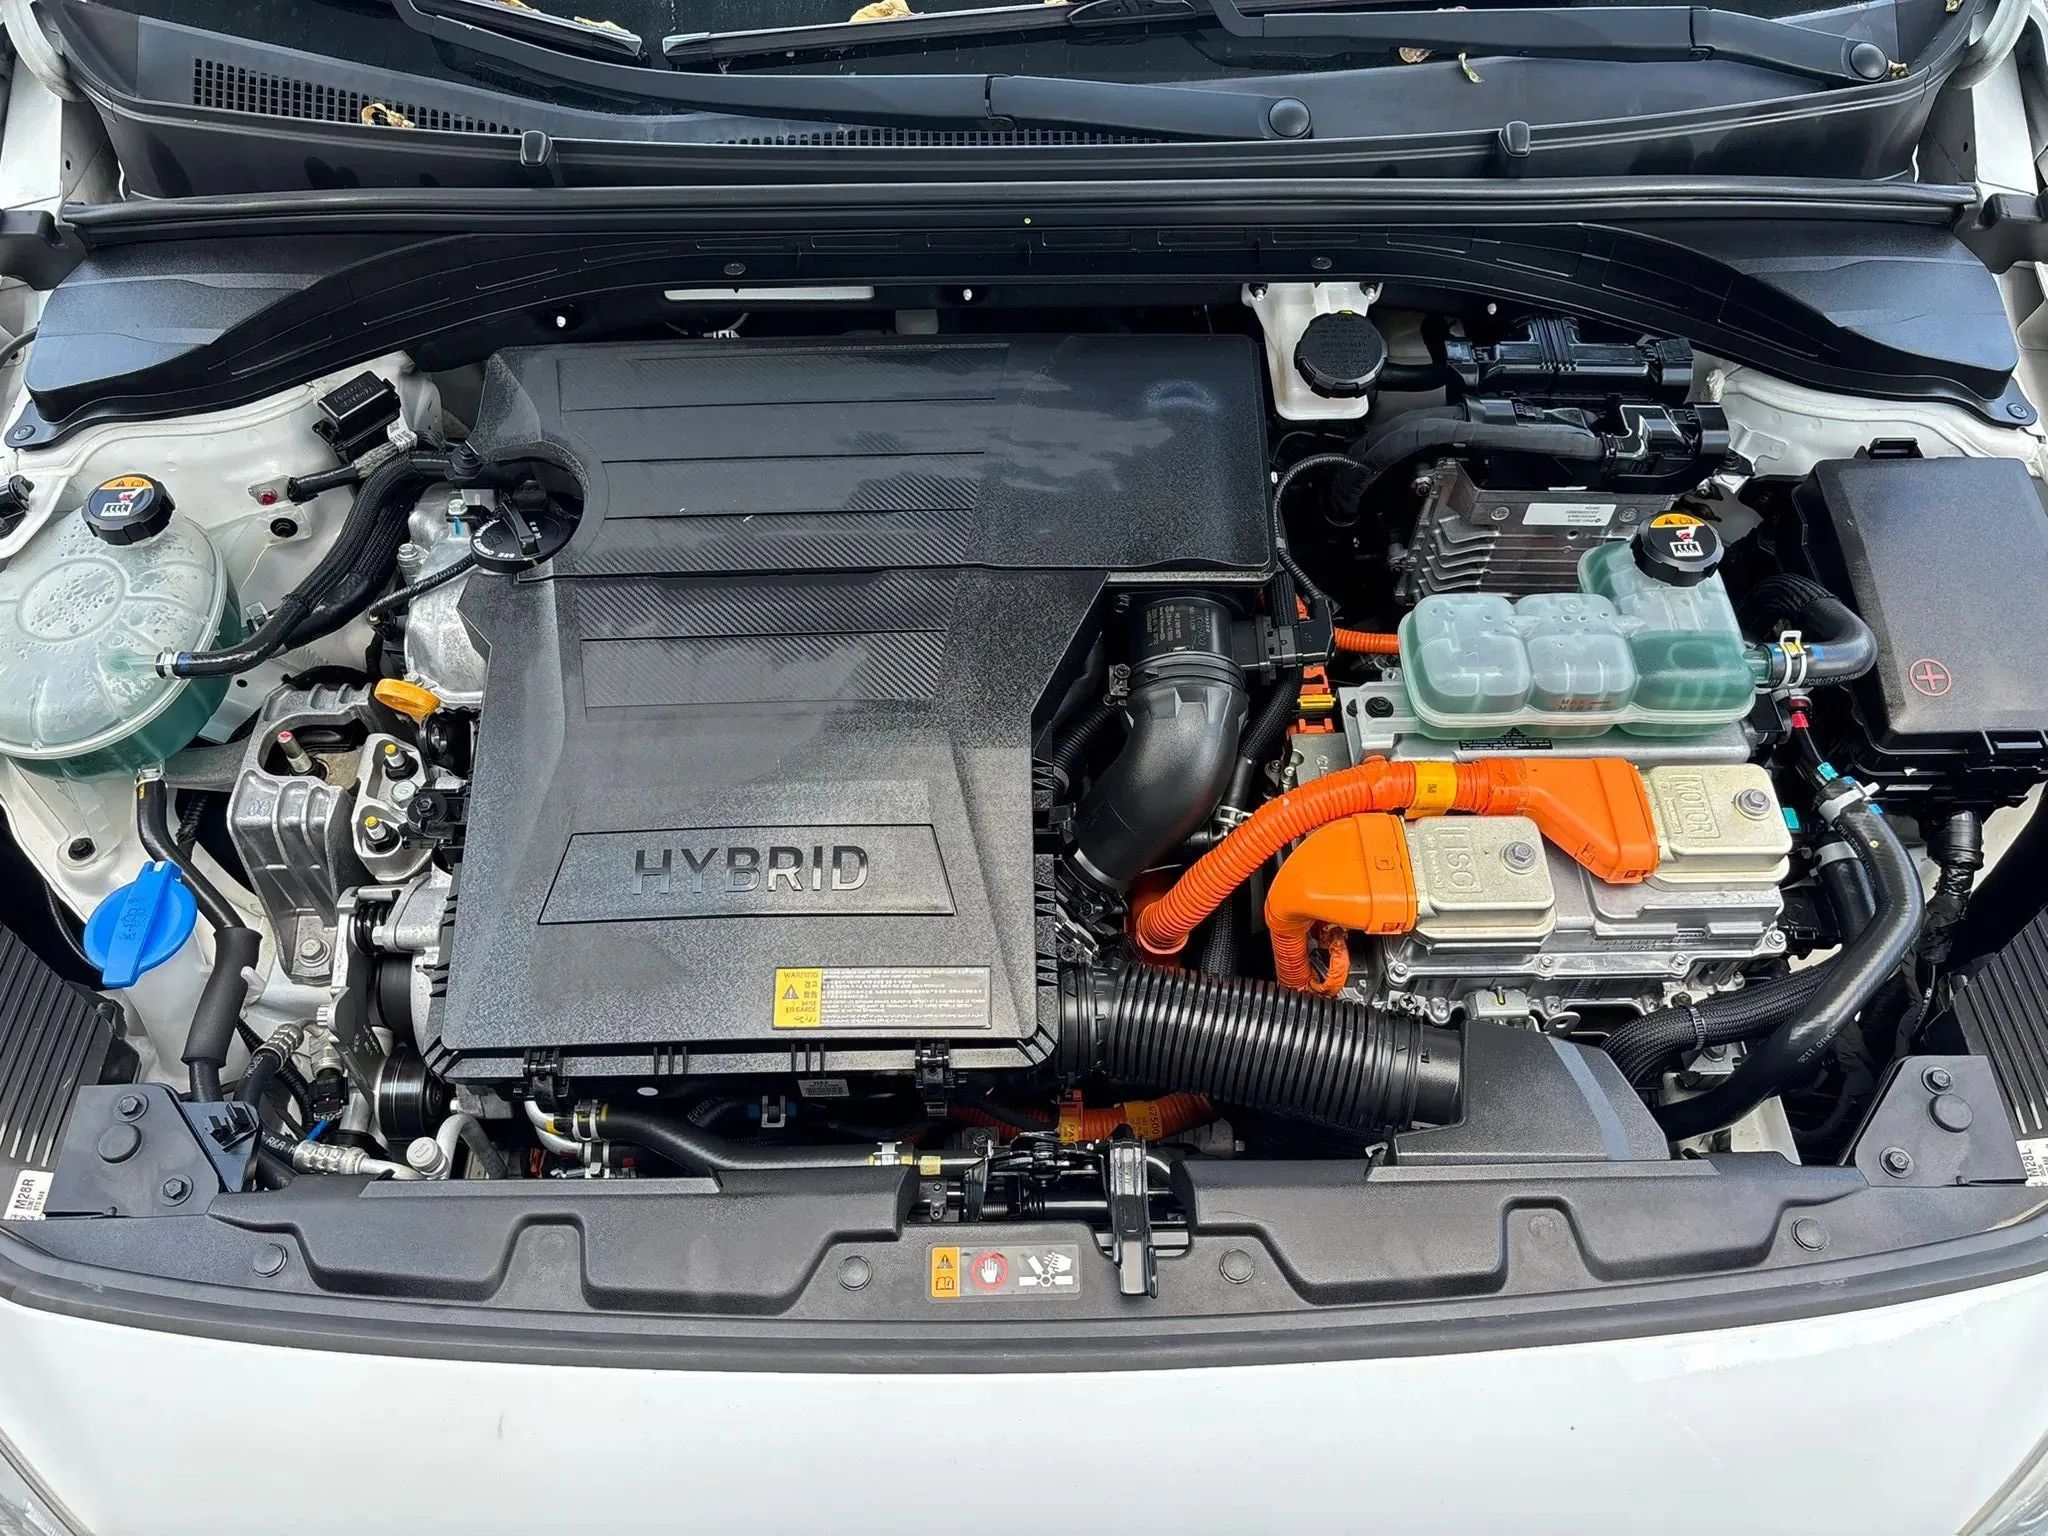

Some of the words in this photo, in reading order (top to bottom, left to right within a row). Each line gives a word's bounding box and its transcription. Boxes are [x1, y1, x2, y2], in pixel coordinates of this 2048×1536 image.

[1675, 779, 1713, 832] MOTOR
[633, 845, 869, 895] HYBRID
[783, 971, 819, 979] WARNING
[2021, 1148, 2040, 1177] M28L
[13, 1178, 36, 1210] M28R
